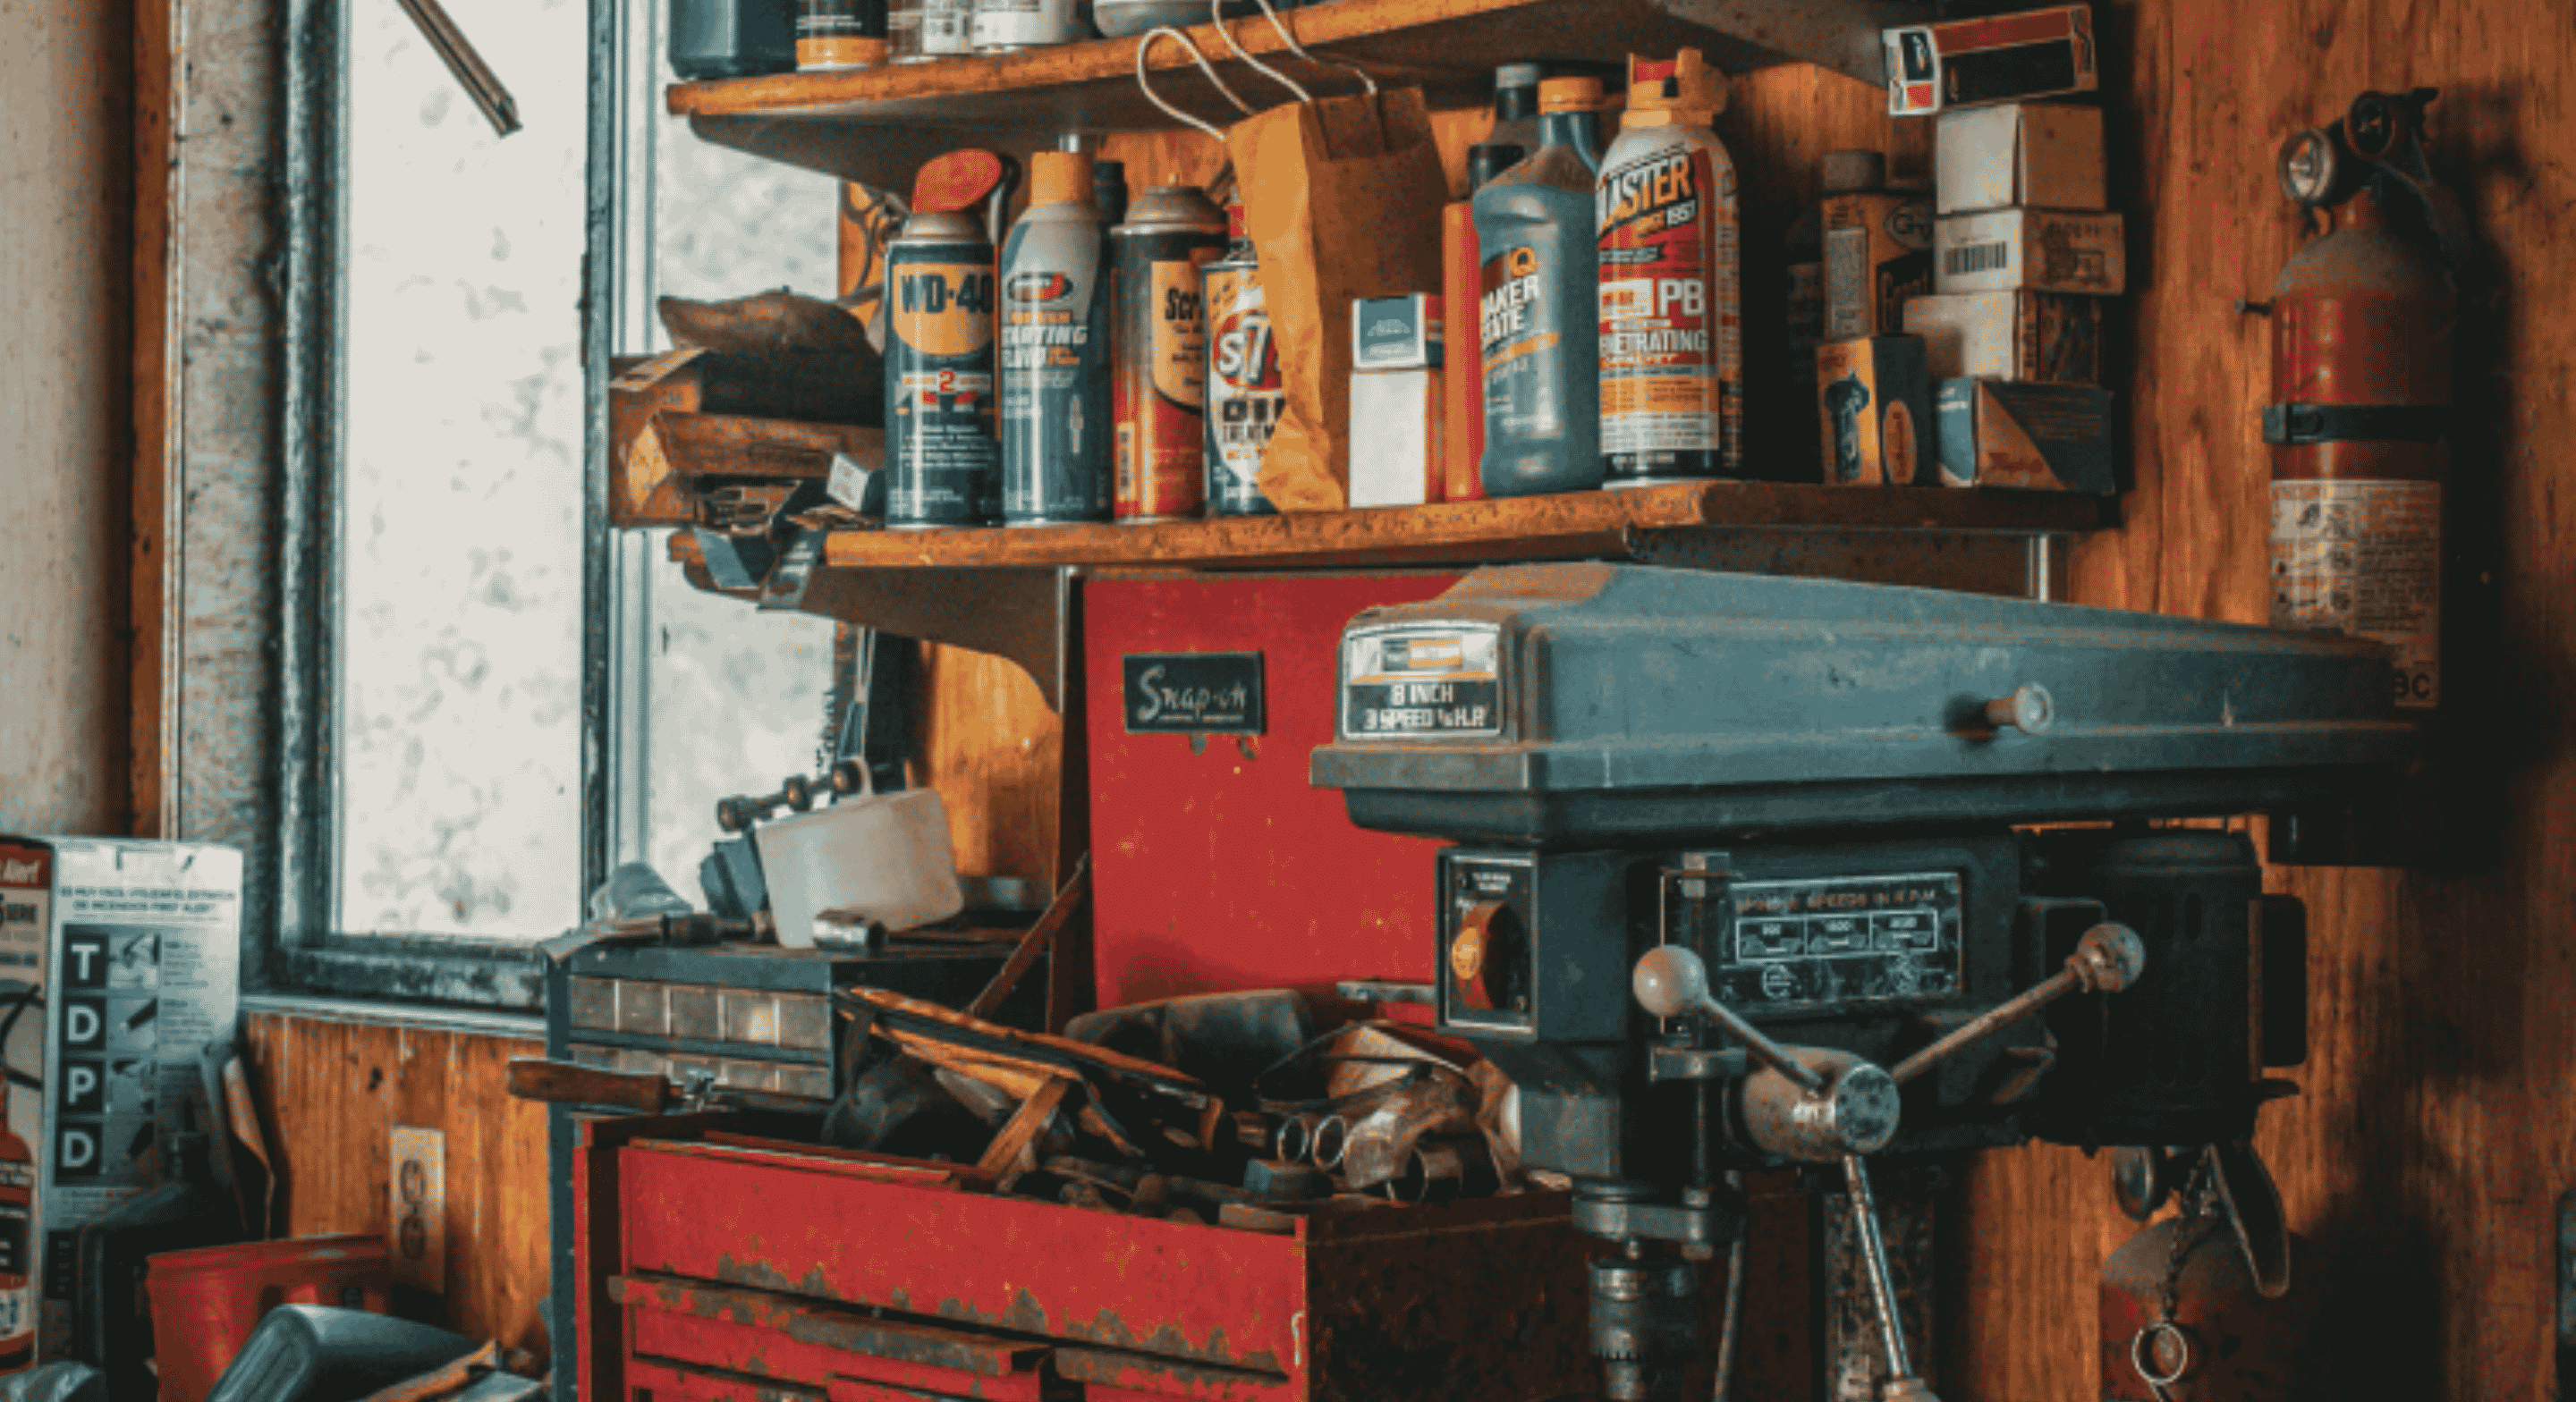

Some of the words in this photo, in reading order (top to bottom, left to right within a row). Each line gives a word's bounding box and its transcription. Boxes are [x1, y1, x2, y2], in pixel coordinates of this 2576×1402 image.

[900, 273, 994, 315] WD-40
[1657, 278, 1706, 317] PB
[1136, 664, 1248, 722] Snap-on
[1390, 683, 1405, 705] 8
[1410, 683, 1453, 705] INCH
[1364, 708, 1377, 731] 3
[1379, 707, 1434, 731] SPEED
[70, 943, 101, 981] T
[67, 1005, 100, 1043] D
[68, 1068, 97, 1105] P
[62, 1130, 95, 1168] D
